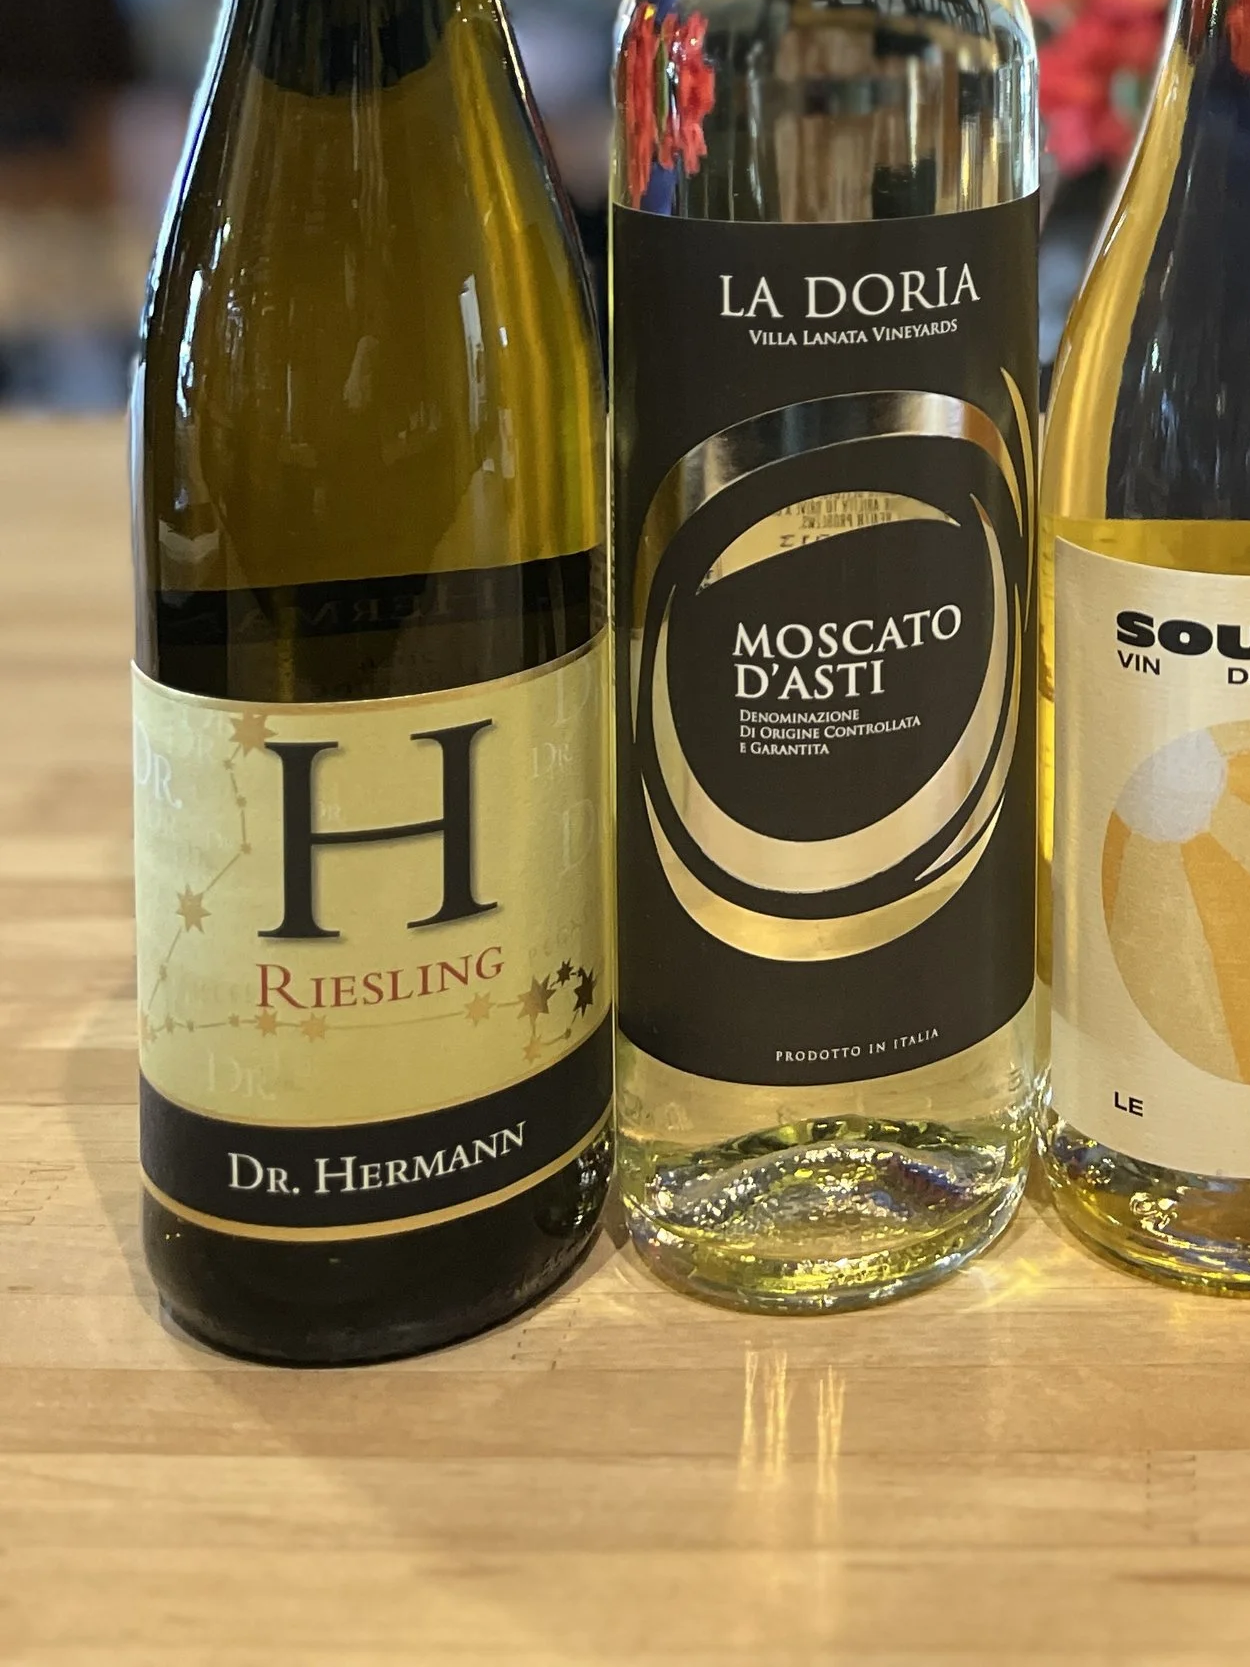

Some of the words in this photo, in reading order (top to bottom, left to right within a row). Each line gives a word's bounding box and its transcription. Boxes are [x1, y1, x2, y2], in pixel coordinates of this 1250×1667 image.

[719, 274, 784, 319] LA
[804, 262, 981, 319] DORIA
[748, 329, 798, 346] VILLA
[803, 329, 868, 346] LANATA
[872, 318, 958, 342] VINEYARDS
[732, 604, 962, 659] MOSCATO
[1116, 649, 1160, 675] VIN
[734, 659, 886, 700] D'ASTI
[739, 709, 860, 724] DENOMINAZIONE
[739, 725, 756, 738] DI
[760, 727, 820, 740] ORIGINE
[824, 715, 922, 739] CONTROLLATA
[739, 742, 746, 753] E
[750, 742, 830, 756] GARANTITA
[257, 718, 498, 938] H
[256, 946, 504, 1010] RIESLING
[775, 1046, 861, 1062] PRODOTTO
[868, 1042, 886, 1055] IN
[893, 1028, 940, 1050] ITALIA
[1114, 1091, 1144, 1117] LE
[228, 1151, 300, 1195] DR.
[314, 1121, 526, 1195] HERMANN
